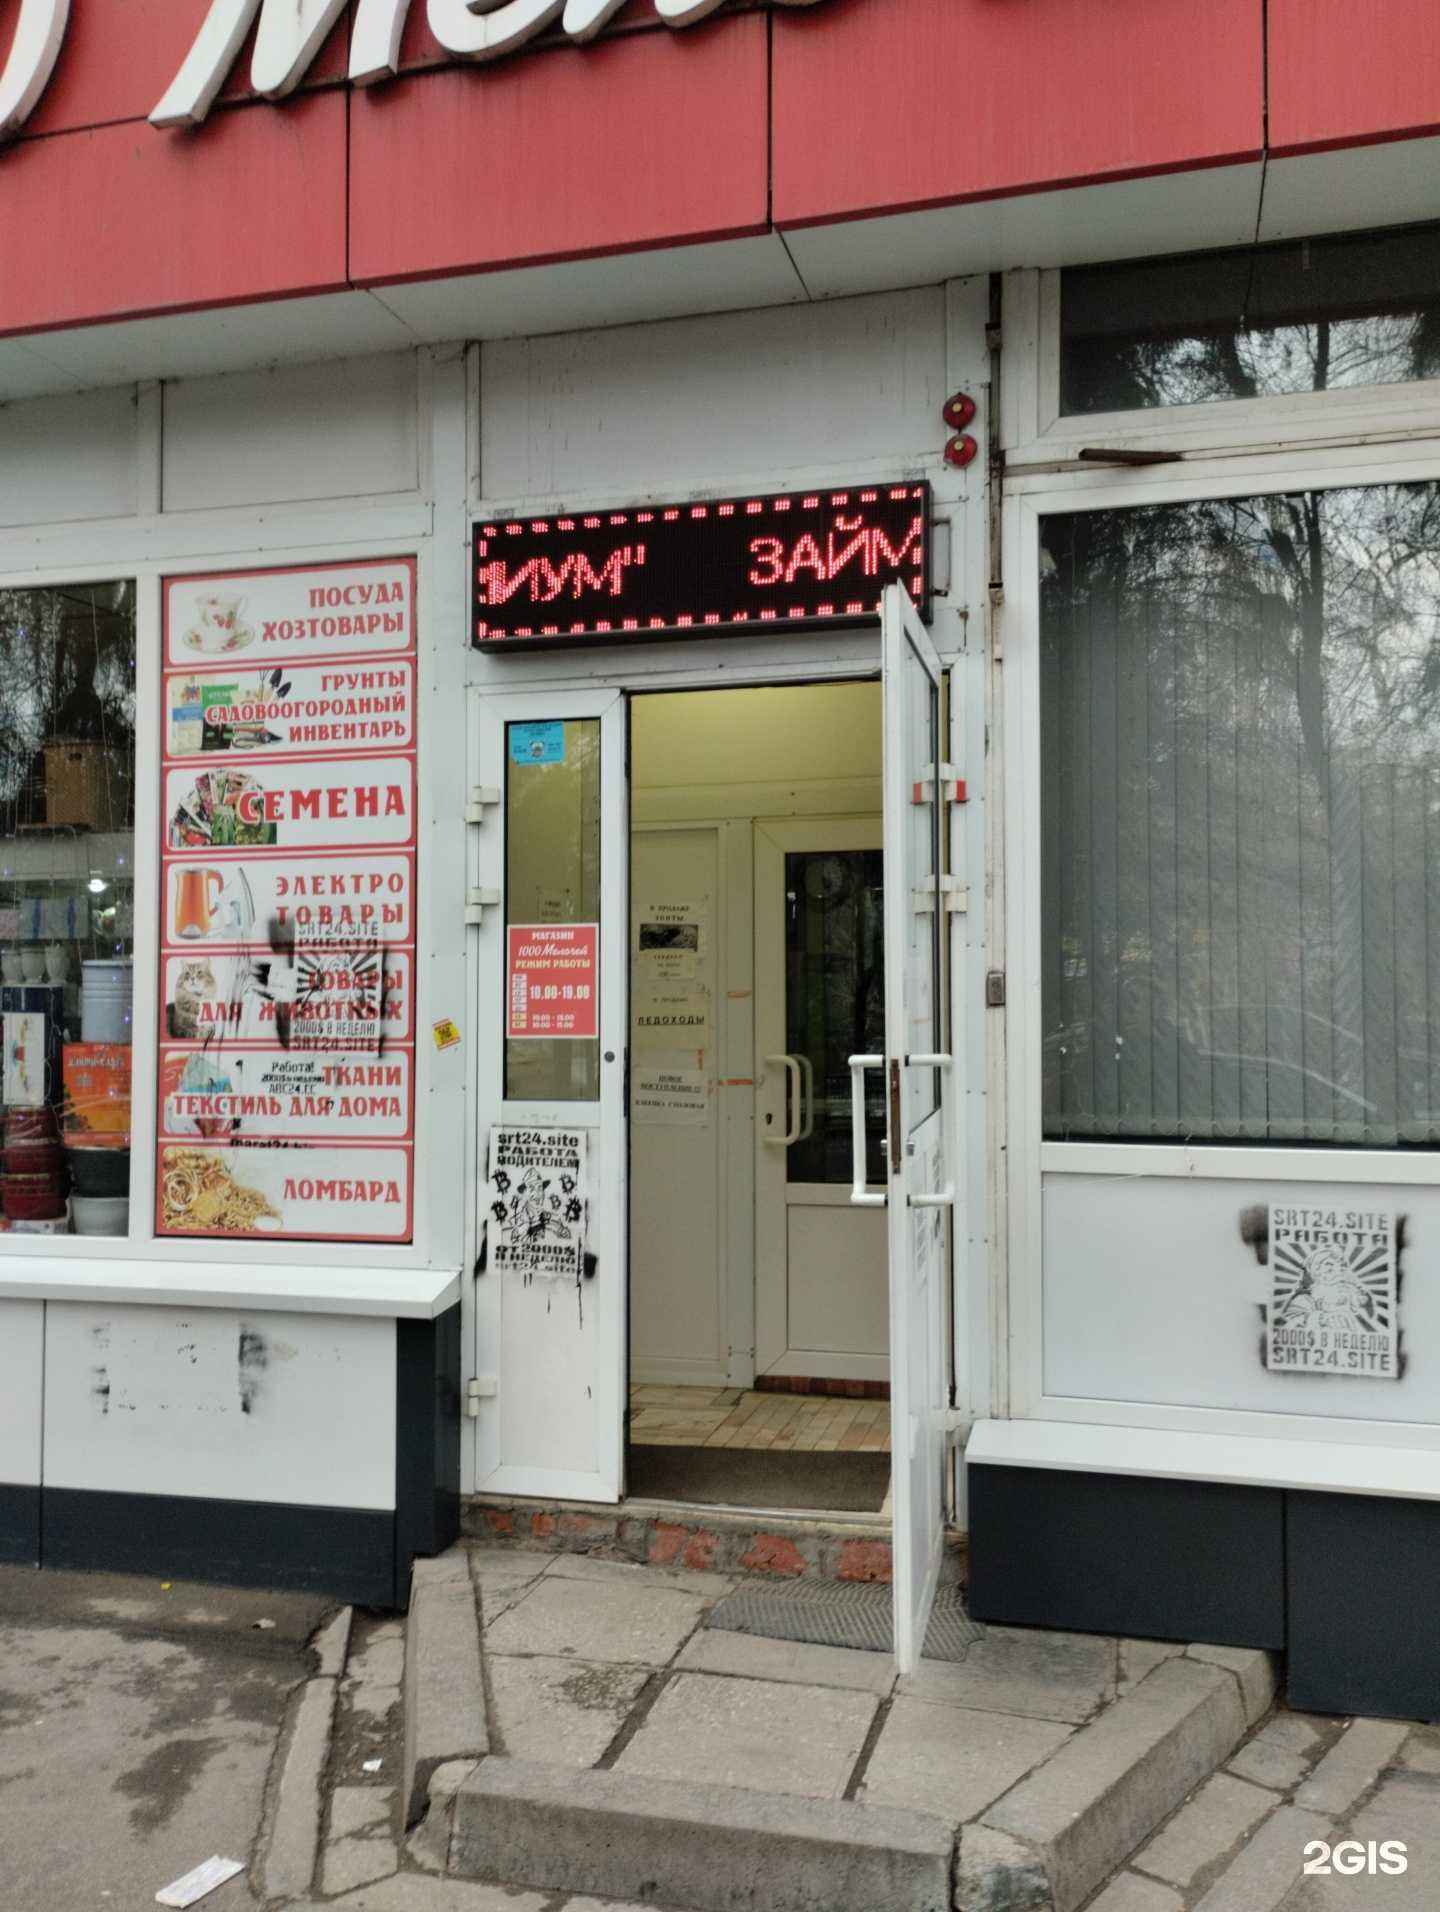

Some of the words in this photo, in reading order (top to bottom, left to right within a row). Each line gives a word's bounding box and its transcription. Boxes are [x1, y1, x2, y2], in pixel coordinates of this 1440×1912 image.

[309, 581, 404, 608] ПОСУДА
[262, 612, 404, 642] ХОЗТОВАРЫ
[321, 670, 406, 692] ГРУНТЫ
[205, 691, 406, 723] САДОВООГОРОДНЫЙ
[289, 721, 406, 743] ИНВЕНТАРЬ
[239, 785, 406, 823] СЕМЕНА
[276, 873, 404, 896] ЭЛЕКТРО
[276, 903, 403, 926] ТОВАРЫ
[532, 931, 575, 941] МАГАЗИН
[518, 945, 541, 957] 1000
[515, 960, 551, 969] РЕЖИМ
[553, 959, 591, 969] РАБОТЫ
[200, 1001, 243, 1022] ДЛЯ
[322, 1065, 402, 1086] ТКАНИ
[174, 1095, 282, 1116] ТЕКСТИЛЬ
[289, 1096, 331, 1117] ДЛЯ
[338, 1096, 402, 1118] ДОМА
[497, 1131, 579, 1147] srt24.site
[497, 1155, 580, 1168] ВОДИТЕЛЕМ
[498, 1145, 578, 1157] РАБОТА
[283, 1178, 401, 1203] ЛОМБАРД
[1273, 1208, 1389, 1231] SRT24.SITE
[1274, 1228, 1388, 1246] РАБОТА
[1272, 1328, 1315, 1348] 2000$
[1320, 1331, 1329, 1348] В
[1334, 1333, 1390, 1351] НЕДЕЛЮ
[1272, 1347, 1391, 1371] SRT24.SITE
